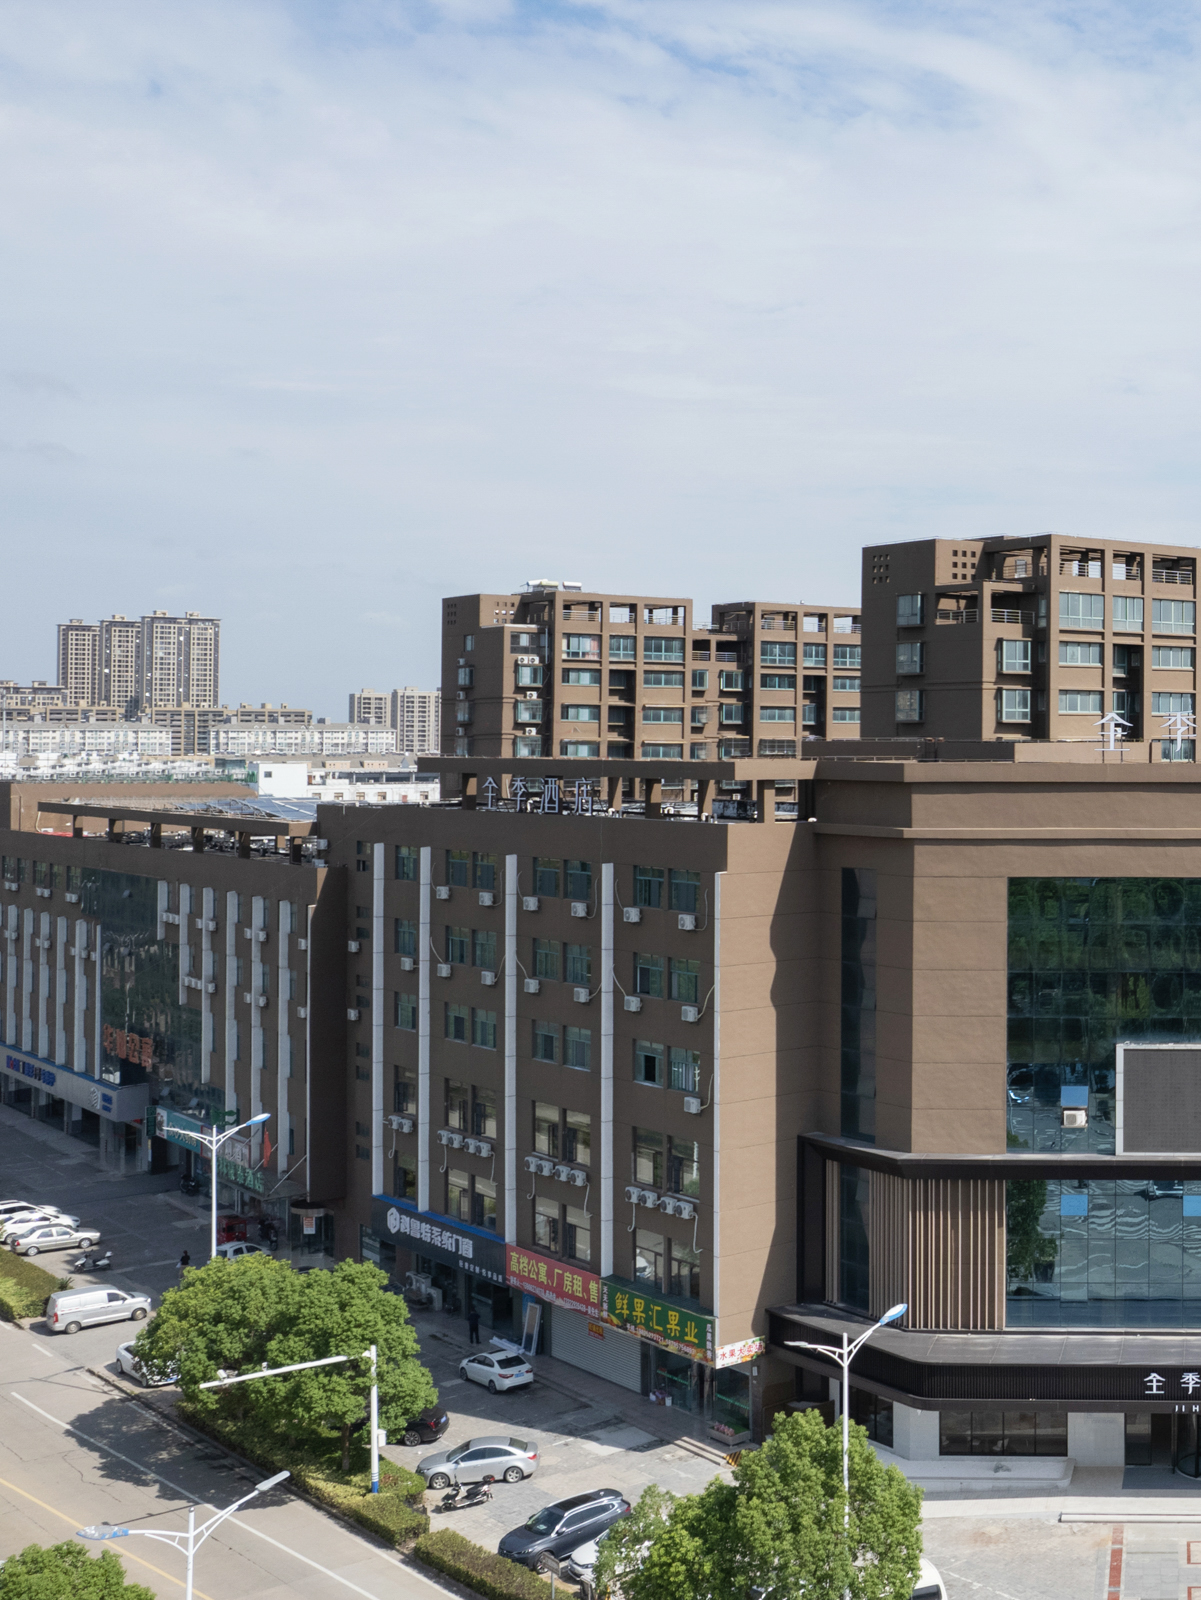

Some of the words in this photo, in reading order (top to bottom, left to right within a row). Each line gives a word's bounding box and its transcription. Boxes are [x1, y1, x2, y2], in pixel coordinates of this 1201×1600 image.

[482, 776, 593, 815] 全季酒店
[615, 1291, 699, 1344] 鲜果汇果业
[1175, 1405, 1186, 1413] JI
